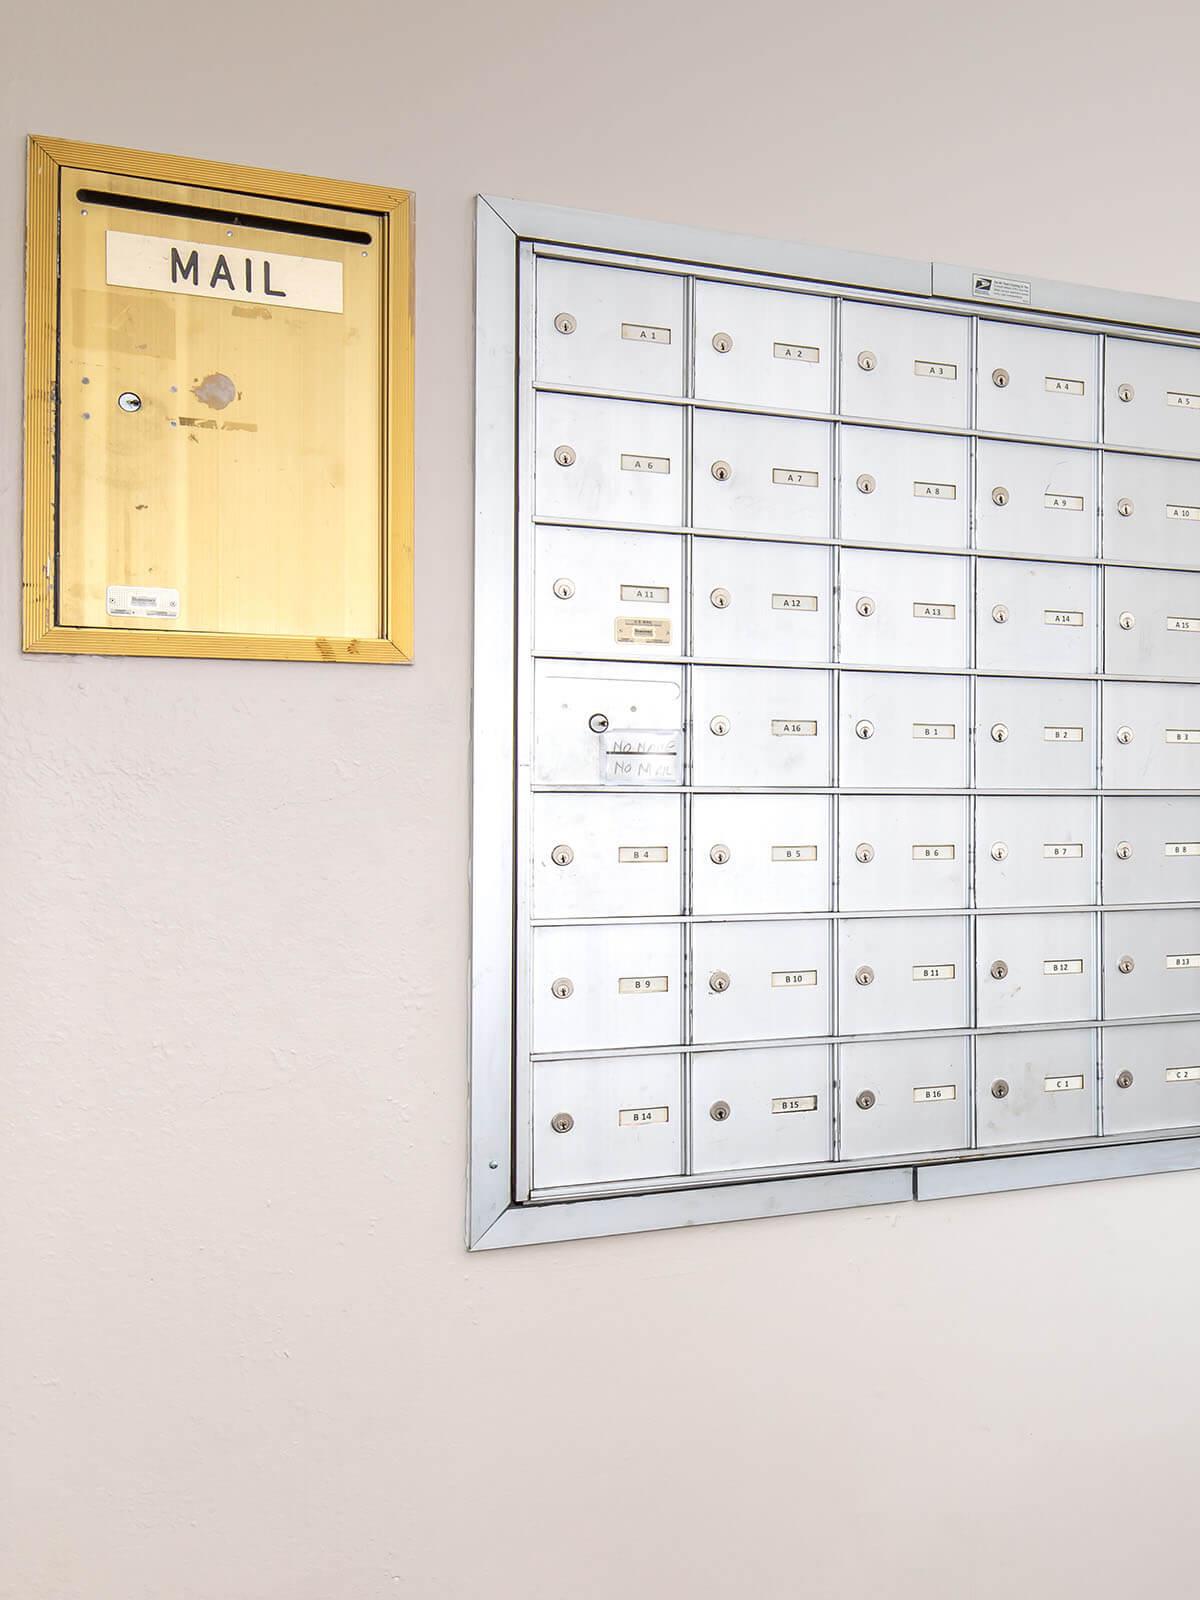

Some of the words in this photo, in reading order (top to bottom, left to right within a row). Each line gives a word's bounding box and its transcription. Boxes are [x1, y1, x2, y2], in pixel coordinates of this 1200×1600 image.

[170, 246, 288, 298] MAIL
[640, 330, 647, 339] A
[651, 332, 656, 340] 1
[785, 348, 792, 357] A
[797, 350, 802, 358] 2
[938, 367, 944, 375] 3
[634, 460, 642, 468] A
[647, 461, 654, 470] 6
[787, 474, 794, 482] A
[797, 474, 802, 482] 7
[926, 487, 932, 495] A
[934, 487, 940, 495] 8
[1061, 499, 1067, 507] 9
[636, 590, 643, 598] A
[644, 591, 654, 599] 11
[783, 599, 790, 607] A
[791, 600, 801, 608] 12
[924, 607, 931, 615] A
[932, 608, 941, 616] 13
[1062, 615, 1070, 623] 14
[783, 724, 790, 732] A
[791, 724, 801, 732] 16
[924, 728, 930, 736] B
[934, 728, 938, 736] 1
[1055, 731, 1060, 739] B
[1063, 731, 1068, 739] 2
[1176, 733, 1182, 741] B
[1184, 733, 1189, 741] 3
[786, 850, 792, 858] B
[795, 850, 801, 858] 5
[925, 849, 931, 857] B
[933, 849, 939, 857] 6
[1054, 848, 1060, 856] B
[1174, 846, 1180, 854] B
[633, 851, 640, 859] B
[1176, 958, 1181, 966] B
[1182, 958, 1190, 966] 13
[1053, 964, 1059, 972] B
[1060, 963, 1068, 971] 12
[923, 969, 929, 977] B
[930, 969, 939, 977] 11
[785, 975, 791, 984] B
[793, 975, 803, 983] 10
[635, 980, 641, 989] B
[644, 980, 651, 989] 9
[1176, 1071, 1181, 1079] C
[1056, 1080, 1062, 1088] C
[1065, 1080, 1069, 1088] 1
[925, 1091, 931, 1099] B
[932, 1090, 942, 1098] 16
[782, 1101, 788, 1110] B
[790, 1101, 799, 1109] 15
[633, 1113, 639, 1122] B
[642, 1112, 652, 1121] 14
